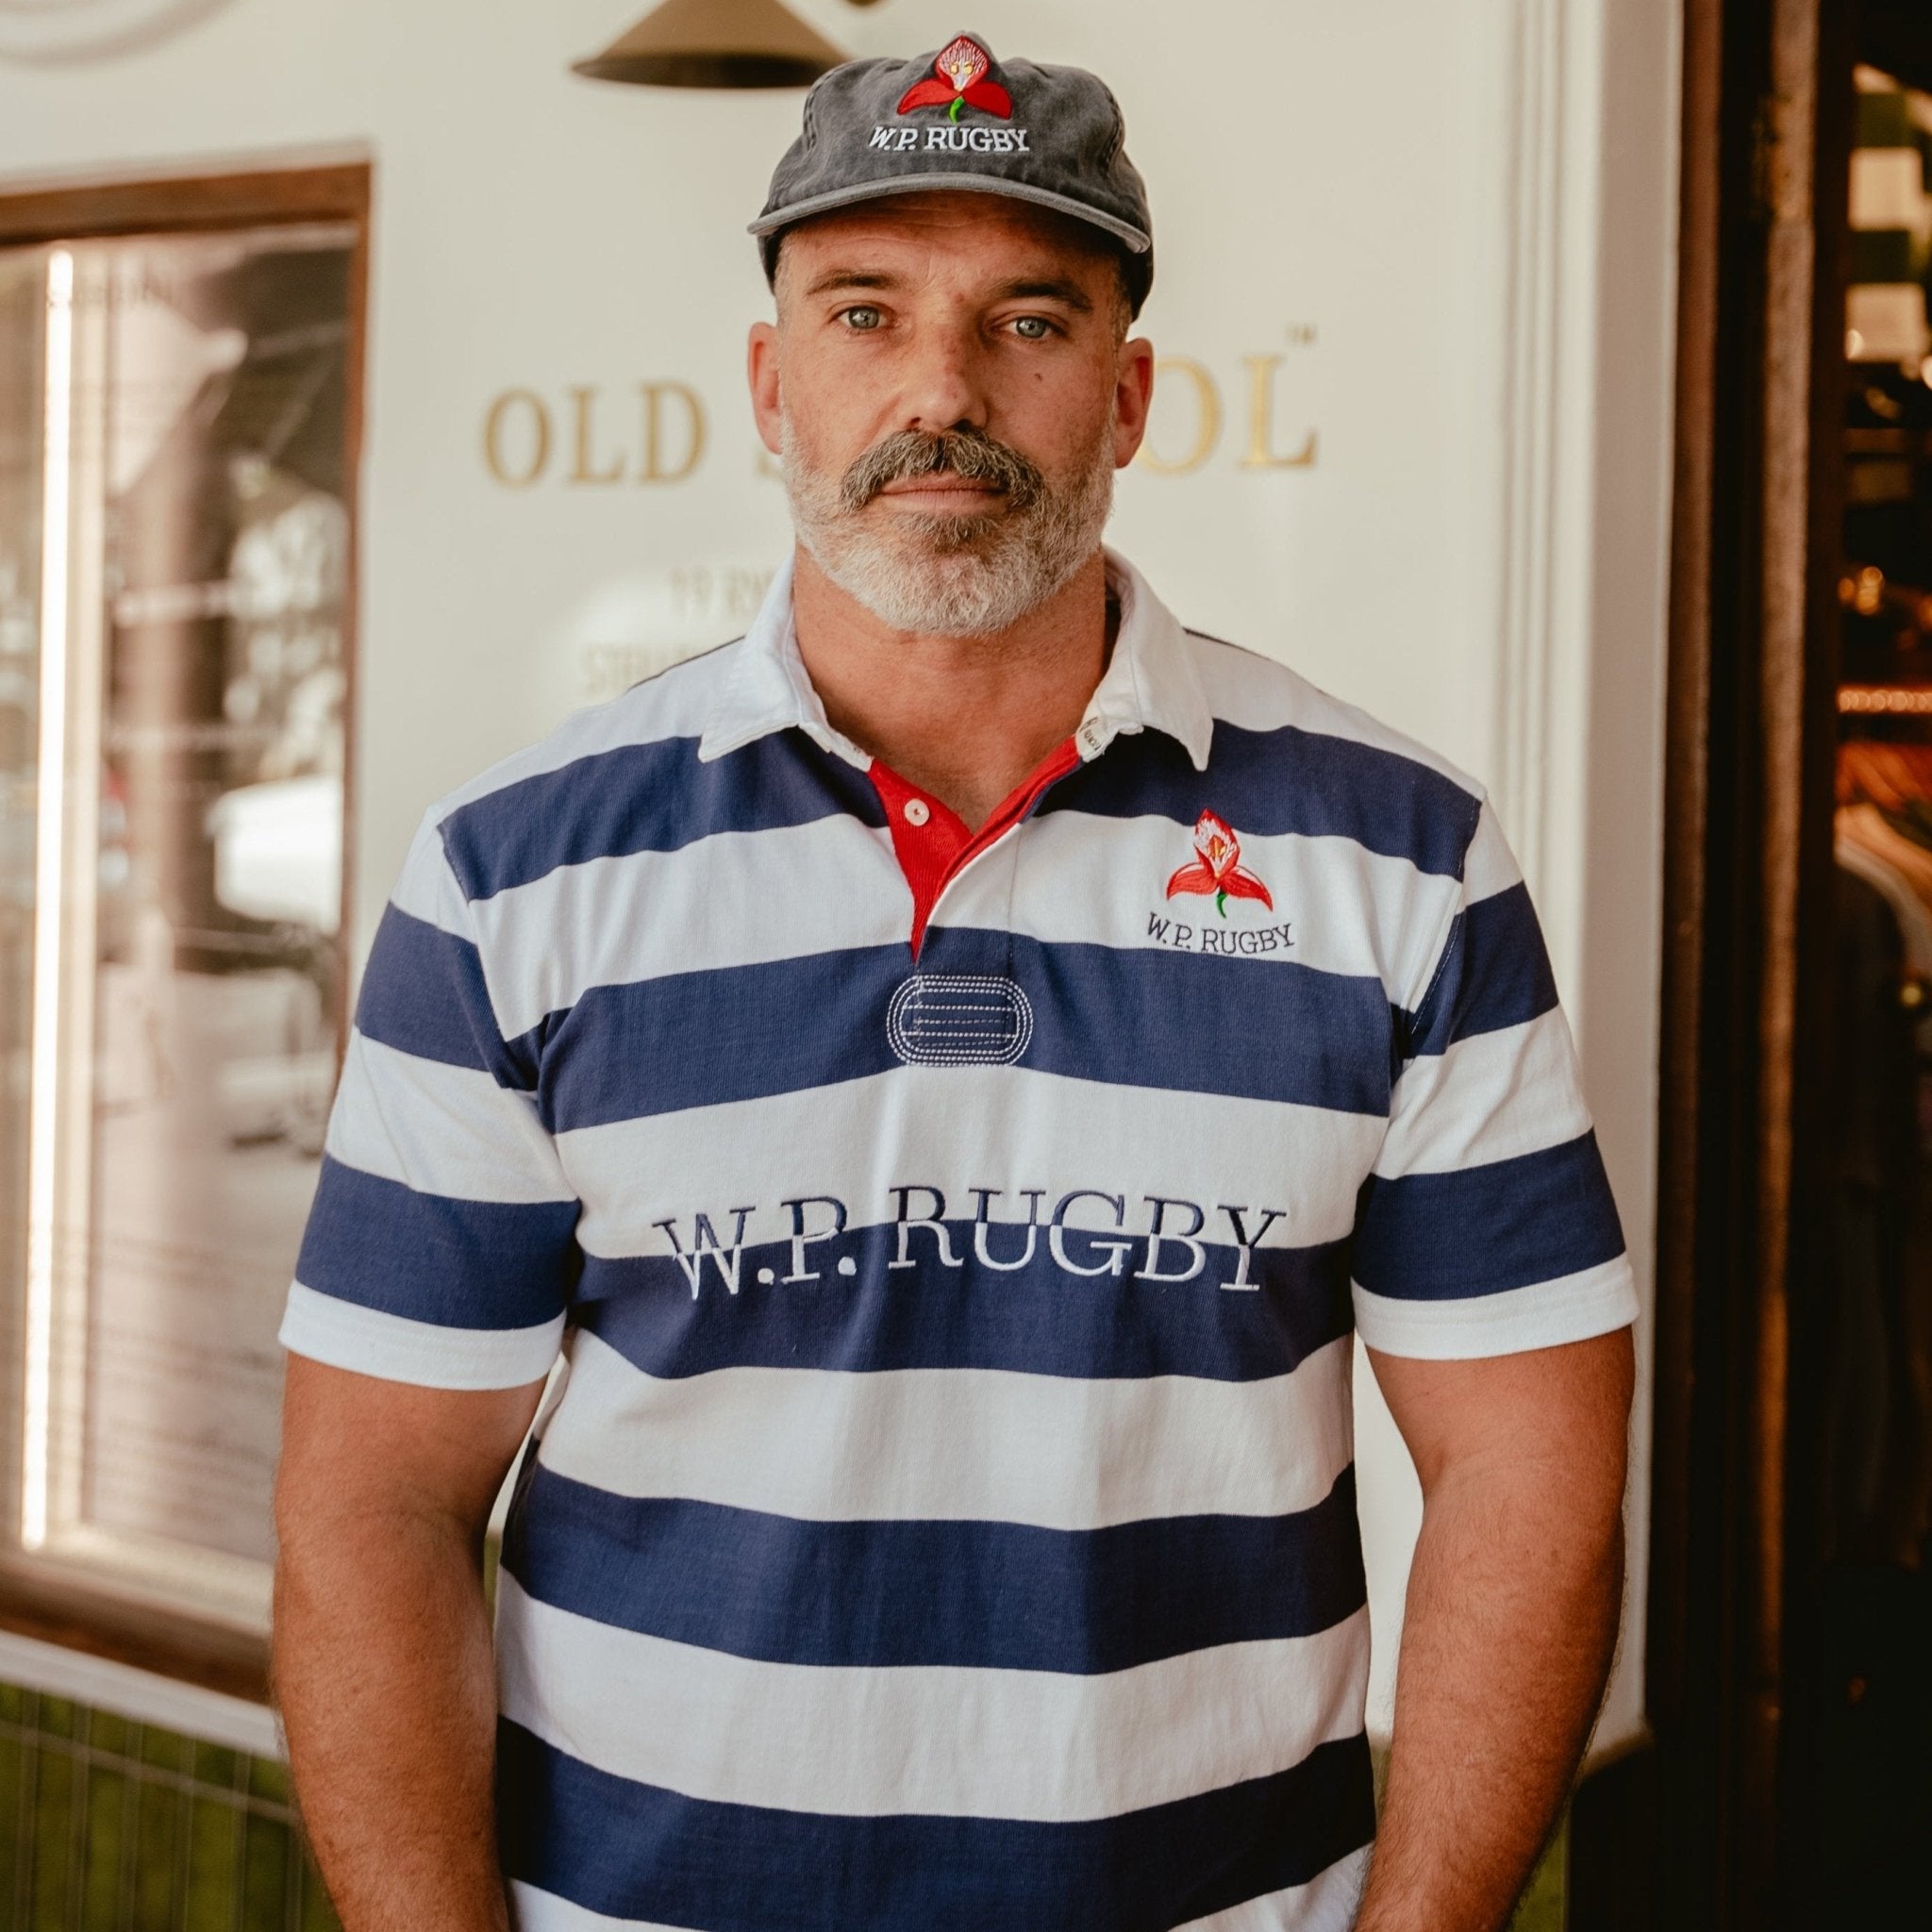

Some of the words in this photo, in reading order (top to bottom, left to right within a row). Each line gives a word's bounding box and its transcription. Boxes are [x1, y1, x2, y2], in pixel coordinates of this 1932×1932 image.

[869, 125, 919, 151] W.P.
[924, 126, 1030, 152] RUGBY
[483, 381, 709, 488] OLD
[1147, 911, 1192, 950] W.P.
[1201, 923, 1295, 955] RUGBY
[652, 1195, 857, 1299] W.P.
[888, 1185, 1287, 1291] RUGBY
